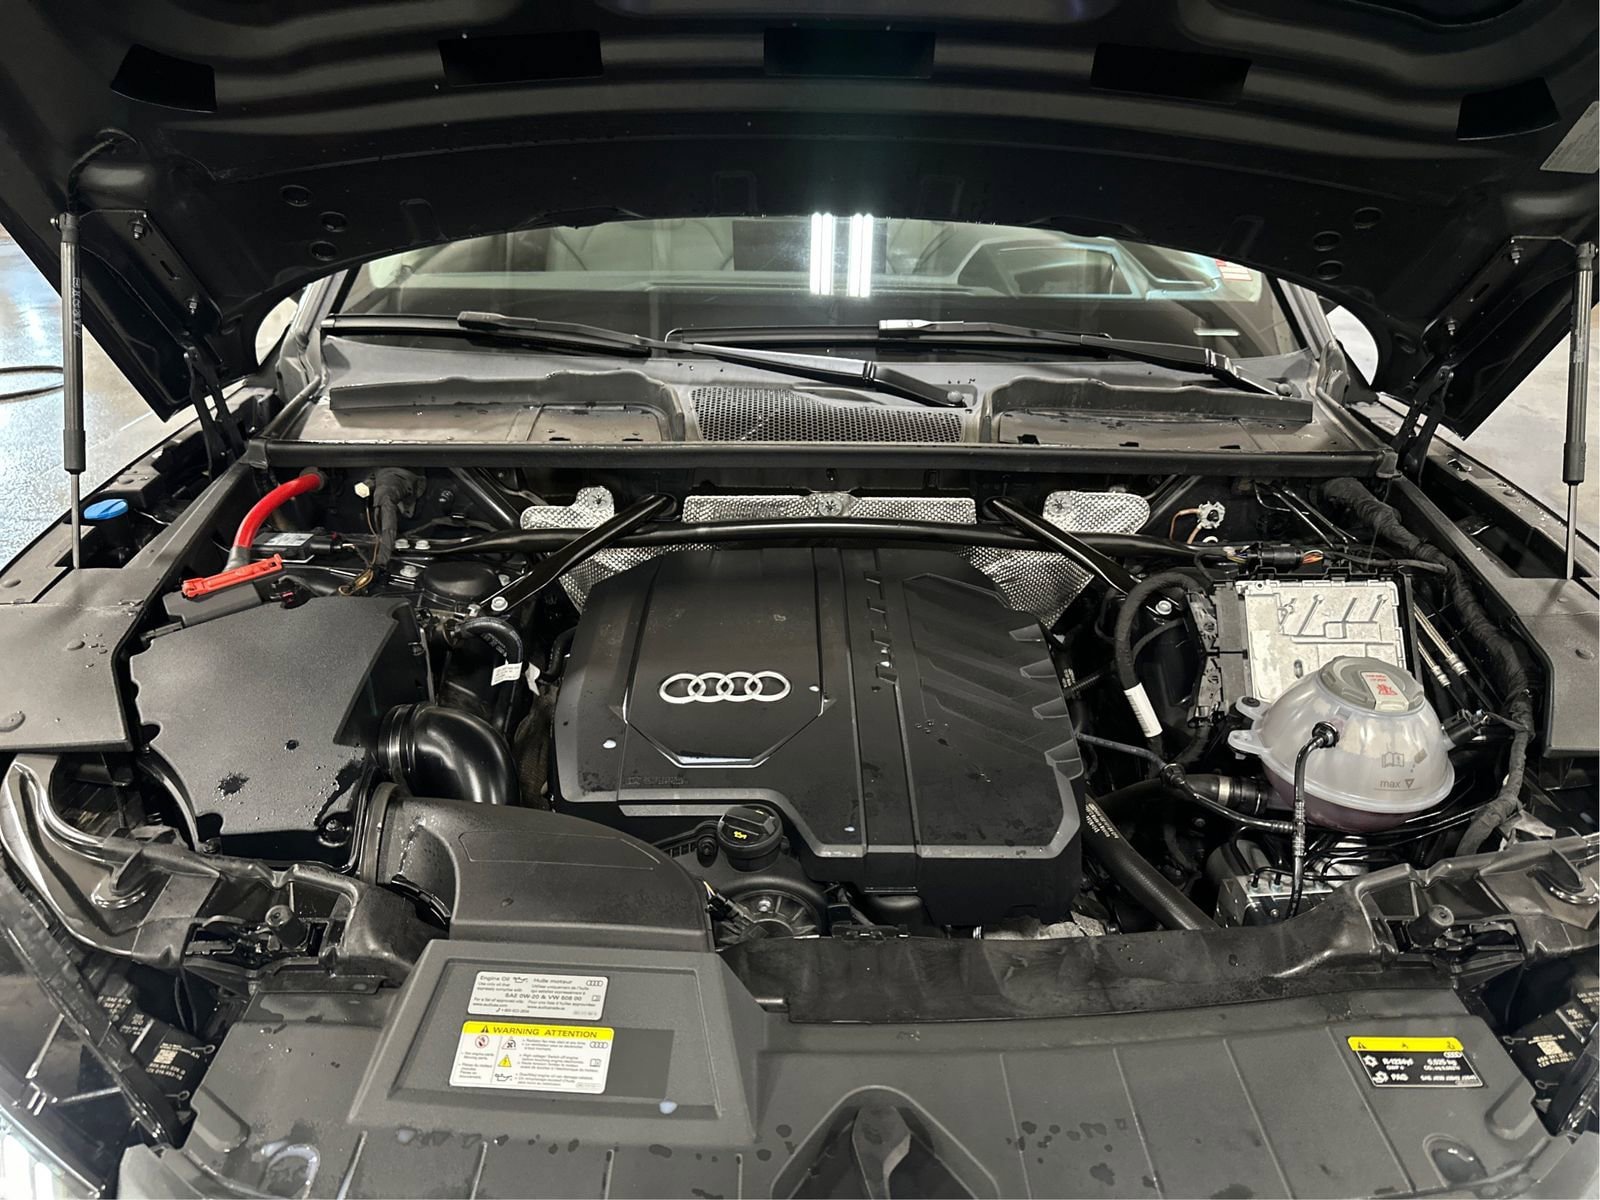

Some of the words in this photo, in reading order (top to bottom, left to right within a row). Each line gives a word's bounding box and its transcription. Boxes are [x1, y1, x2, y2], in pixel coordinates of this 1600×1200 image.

[1380, 780, 1400, 788] max
[493, 1027, 539, 1035] WARNING
[544, 1030, 597, 1038] ATTENTION
